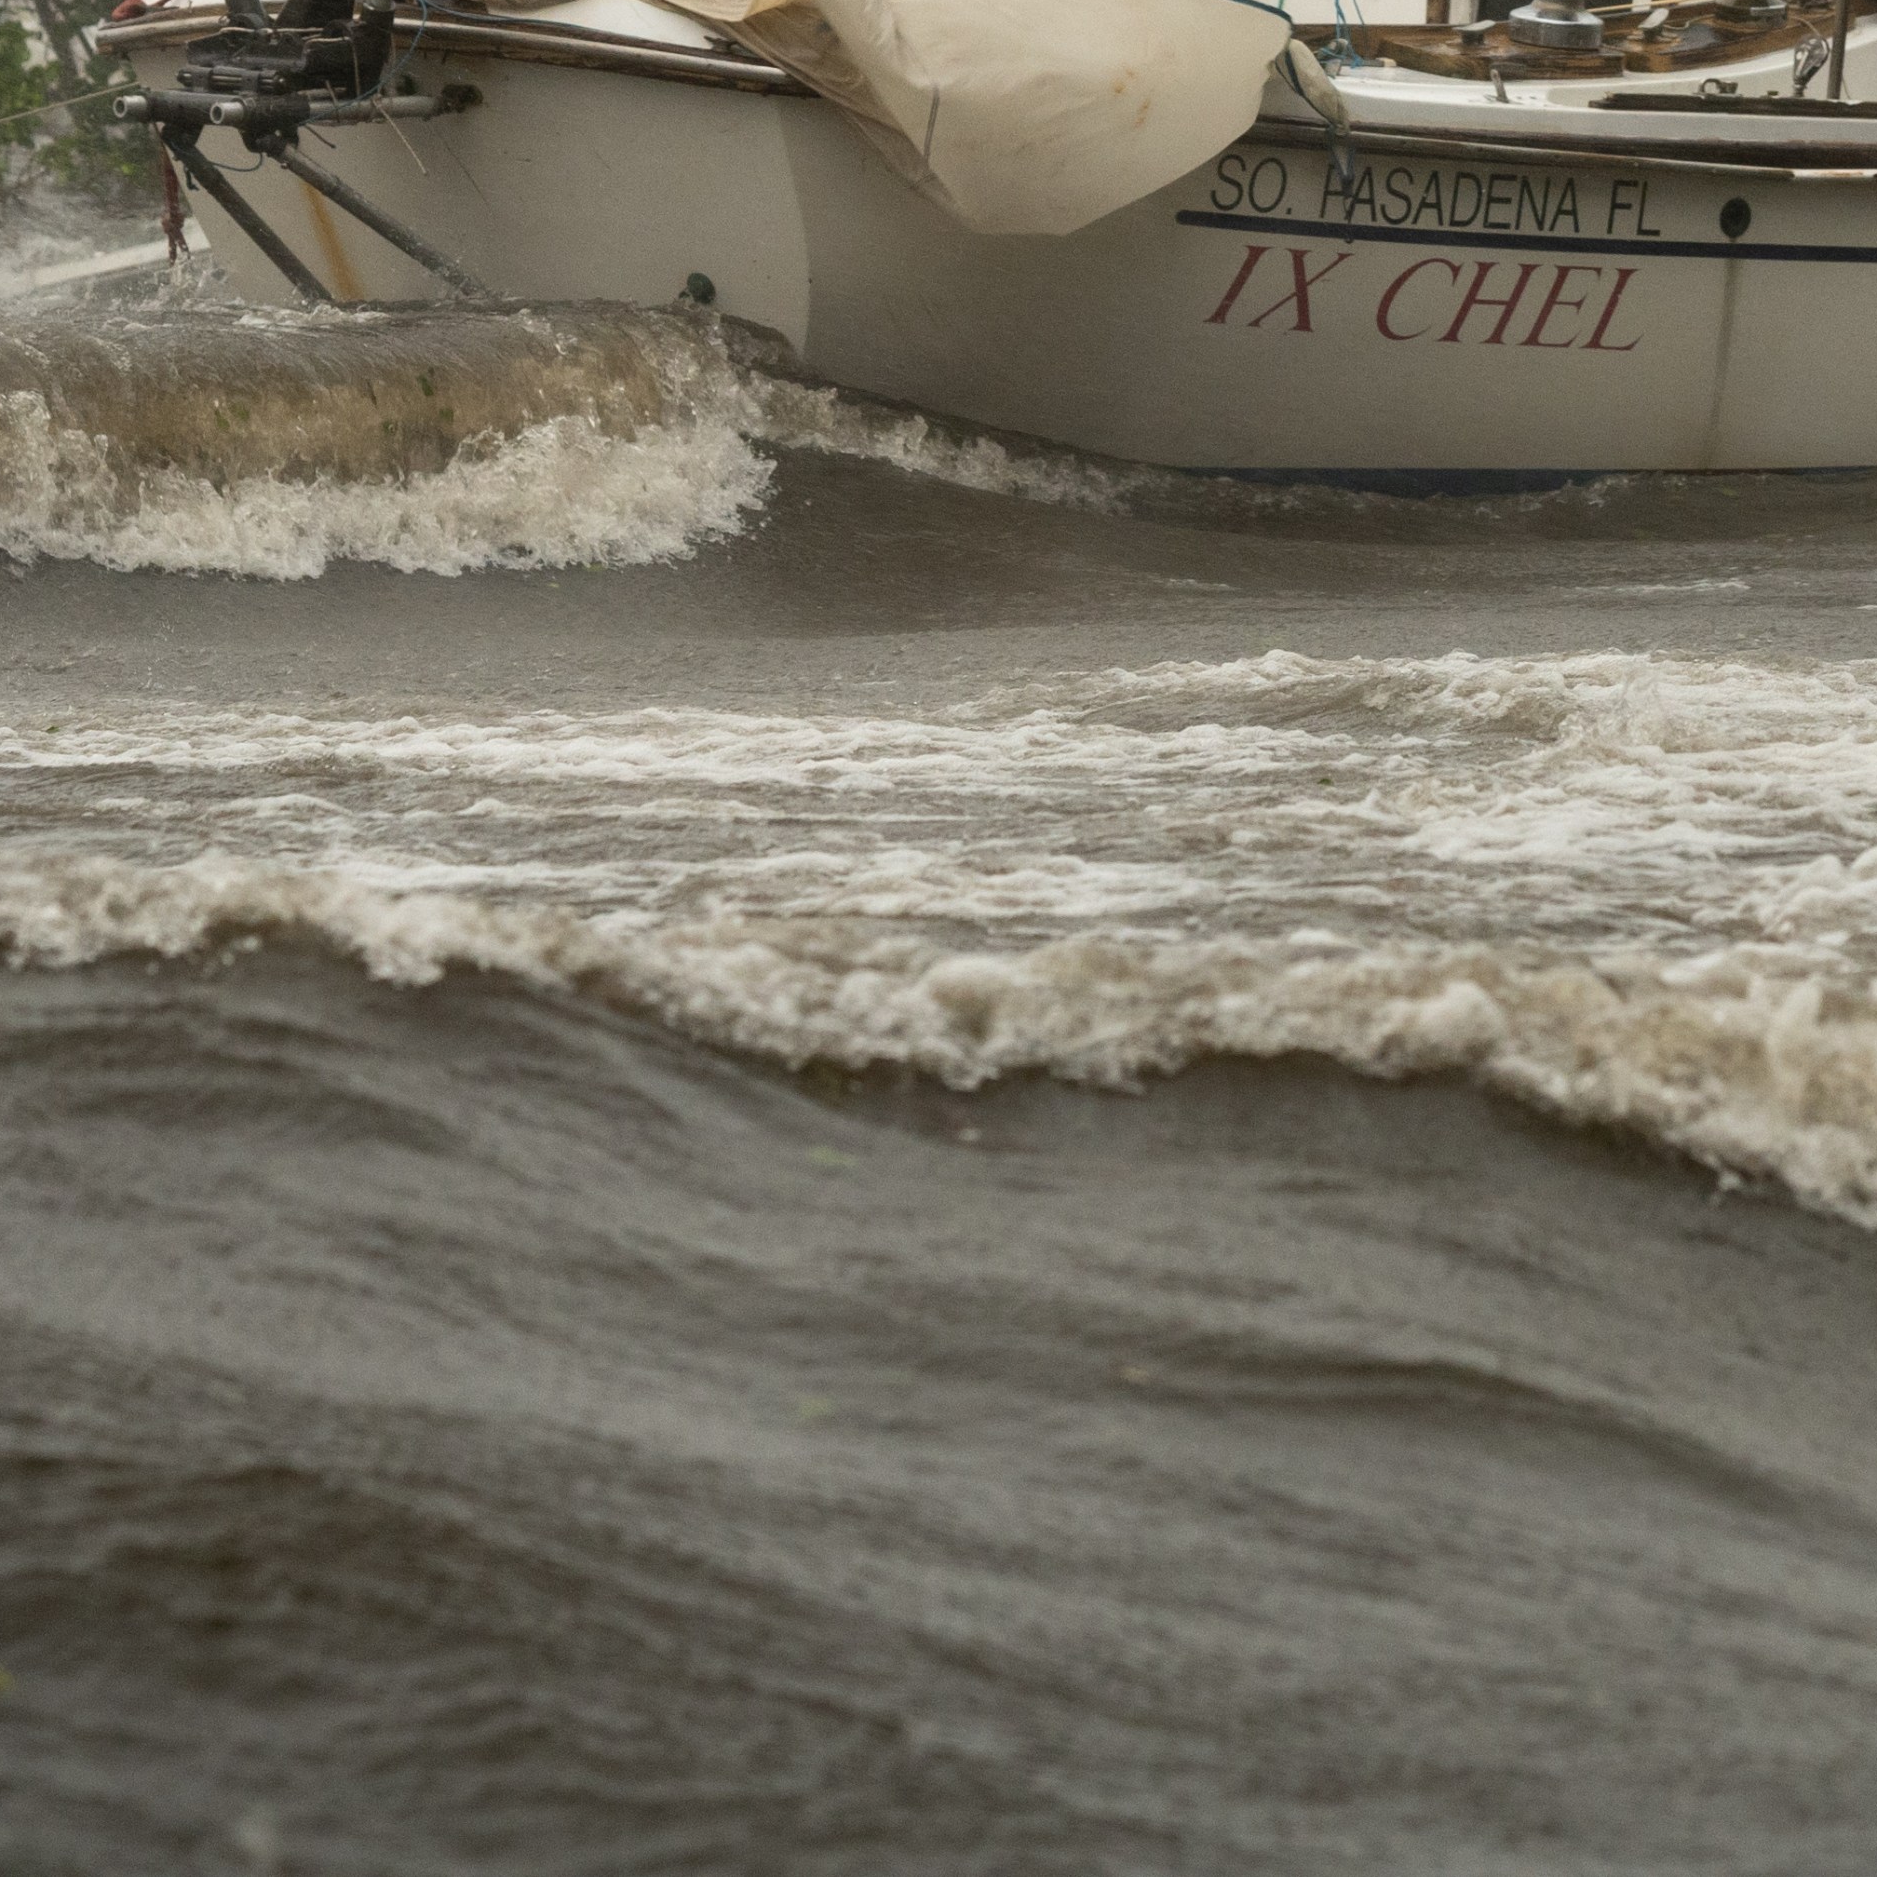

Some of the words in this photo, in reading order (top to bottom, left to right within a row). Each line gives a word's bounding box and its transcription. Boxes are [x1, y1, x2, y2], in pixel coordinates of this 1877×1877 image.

[1210, 153, 1293, 216] SO.
[1321, 164, 1580, 234] PASADENA
[1607, 179, 1661, 236] FL
[1203, 244, 1355, 333] IX
[1375, 257, 1643, 352] CHEL
